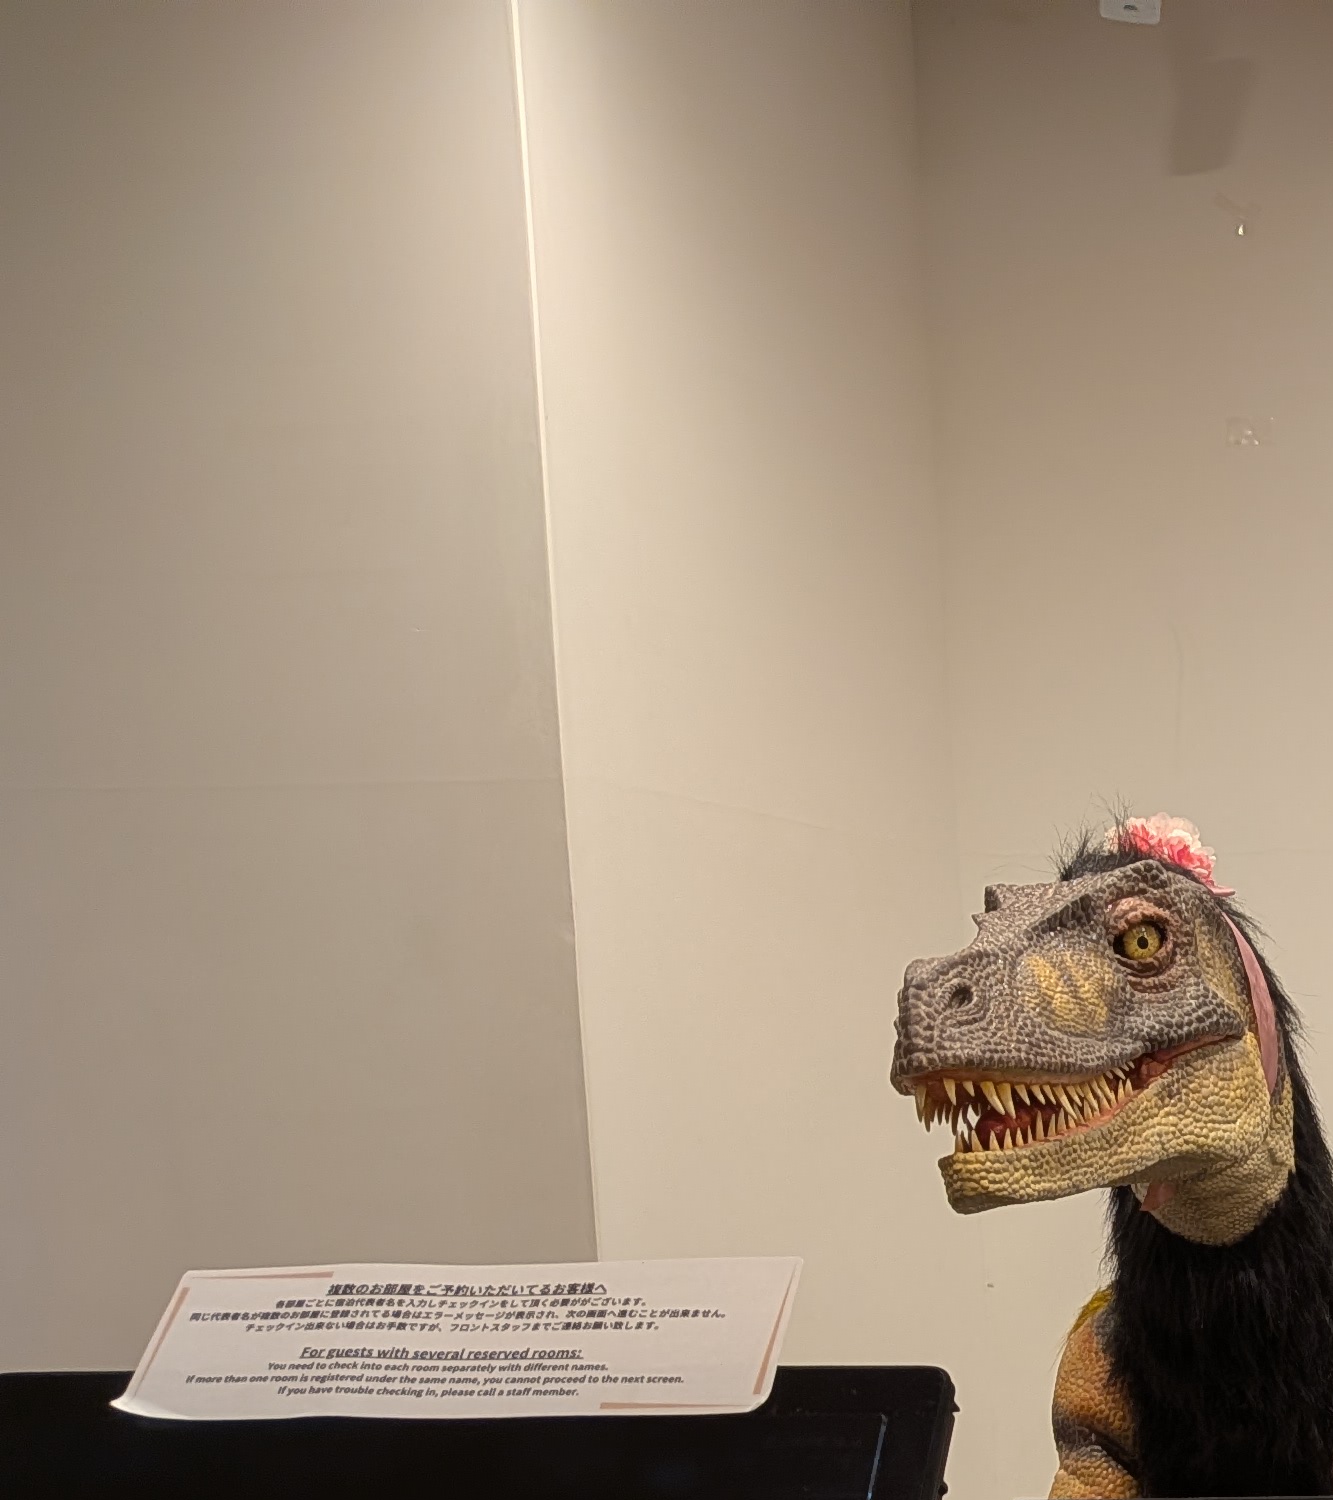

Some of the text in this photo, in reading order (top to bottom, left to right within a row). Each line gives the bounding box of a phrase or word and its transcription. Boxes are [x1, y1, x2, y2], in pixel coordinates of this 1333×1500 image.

[299, 1347, 586, 1360] For guests with several reserved rooms:
